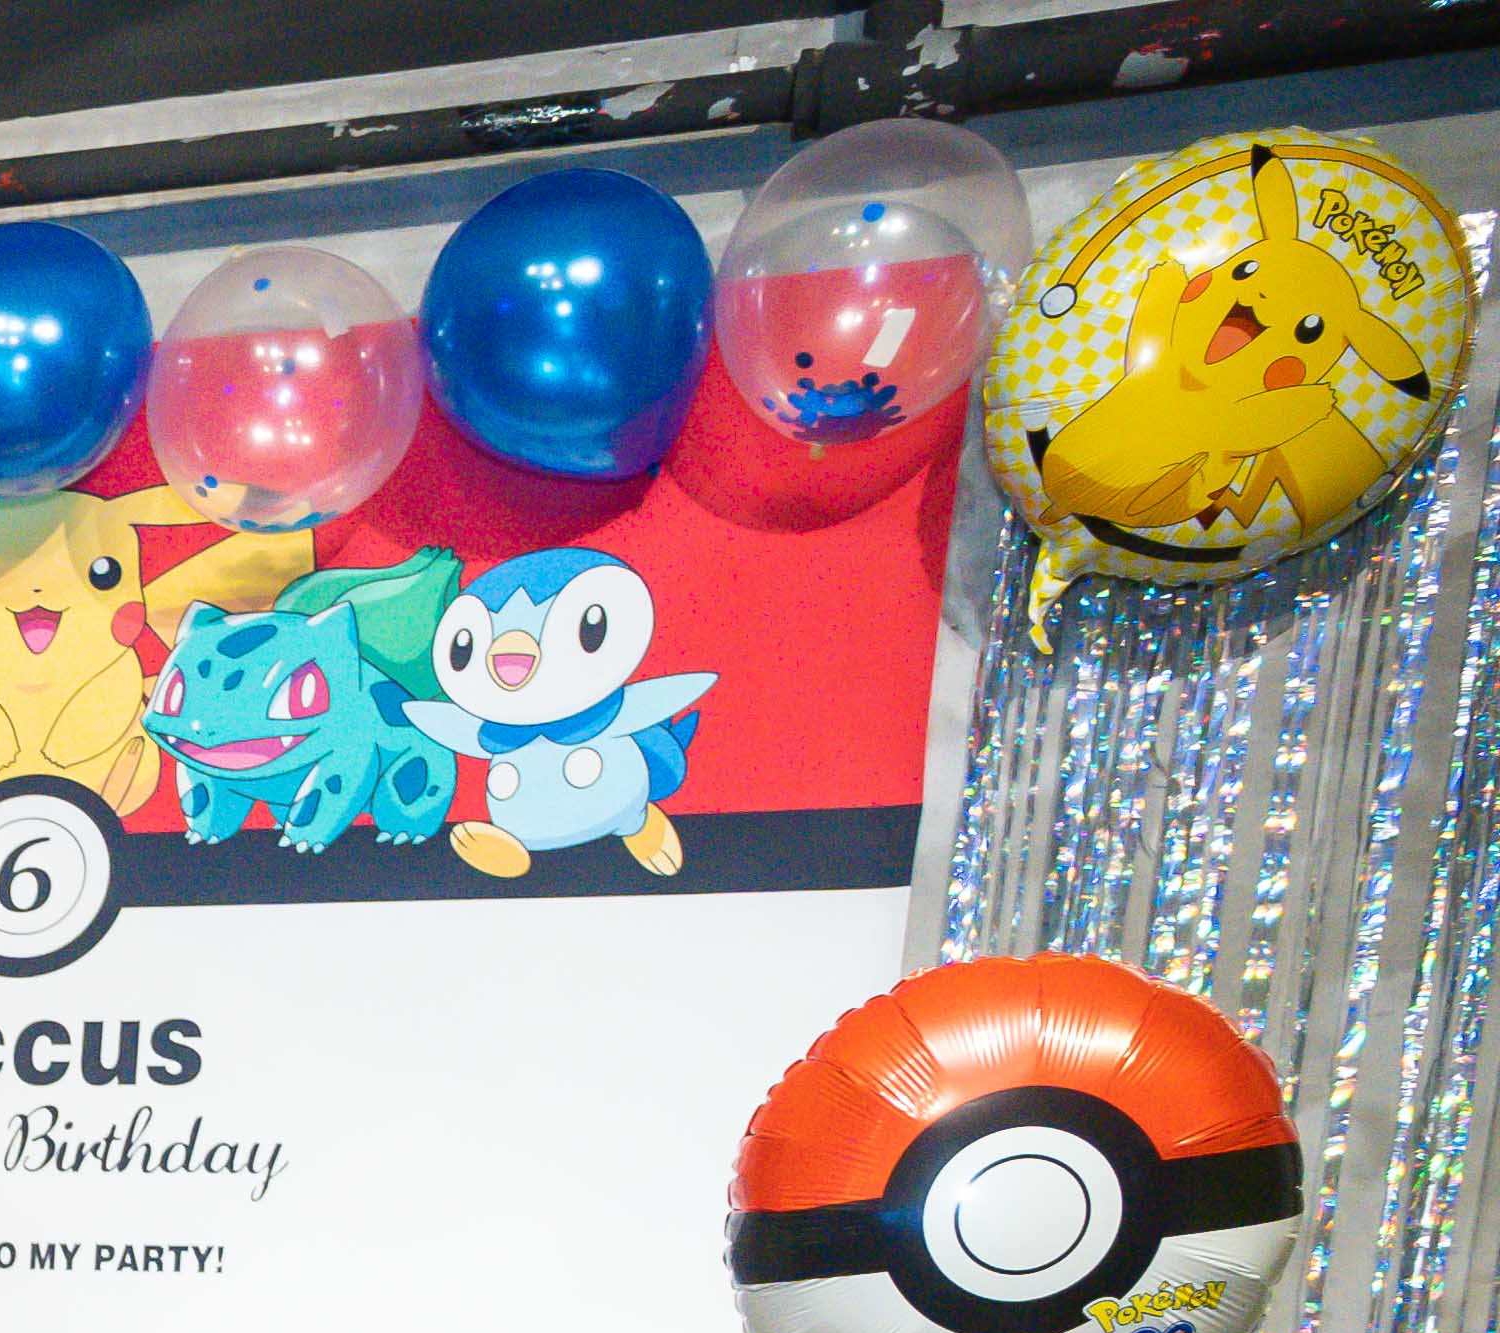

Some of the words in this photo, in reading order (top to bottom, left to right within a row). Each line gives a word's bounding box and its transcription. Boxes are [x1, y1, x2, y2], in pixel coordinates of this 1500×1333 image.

[4, 1104, 289, 1202] Birthday
[30, 1243, 80, 1271] MY
[95, 1244, 225, 1274] PARTY!
